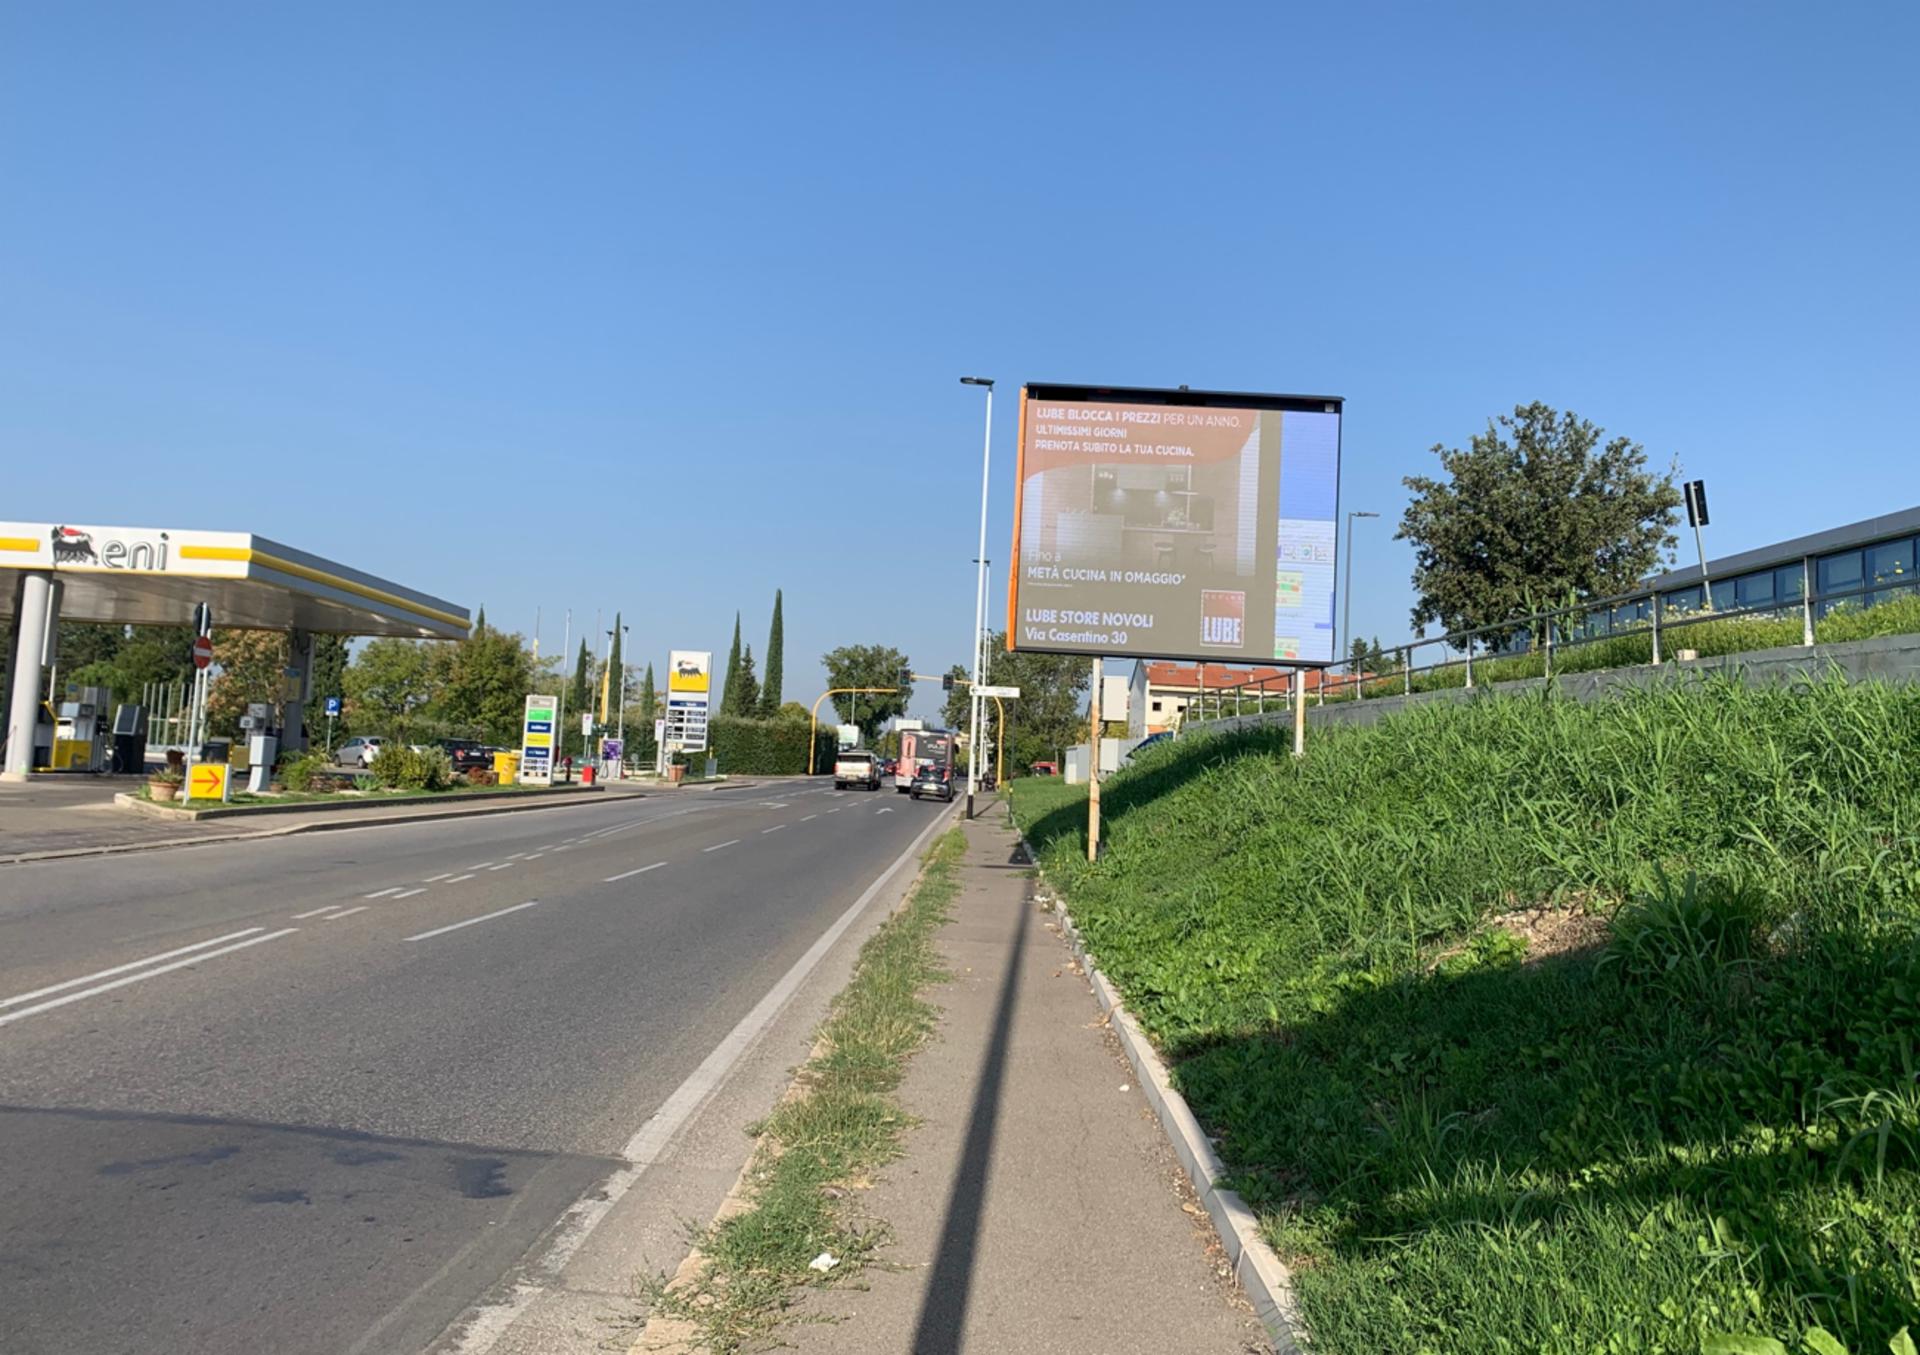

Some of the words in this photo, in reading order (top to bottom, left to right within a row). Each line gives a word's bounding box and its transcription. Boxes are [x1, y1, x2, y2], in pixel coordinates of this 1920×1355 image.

[1036, 407, 1065, 420] LUBE
[1067, 409, 1113, 421] BLOCCA
[1115, 411, 1120, 422] I
[1122, 411, 1161, 424] PREZZI
[1163, 413, 1185, 425] PER
[1187, 414, 1204, 426] UN
[1206, 415, 1241, 428] ANNO.
[1035, 424, 1092, 437] ULTIMISSIMI
[1093, 426, 1128, 438] GIORNI
[1034, 439, 1080, 451] PRENOTA
[1082, 441, 1117, 453] SUBITO
[1119, 443, 1132, 454] LA
[1134, 444, 1153, 455] TUA
[1155, 445, 1195, 457] CUCINA.
[101, 531, 169, 571] eni
[1027, 564, 1060, 580] METÀ
[1062, 568, 1107, 582] CUCINA
[1109, 570, 1122, 583] IN
[1025, 608, 1058, 624] LUBE
[1059, 610, 1100, 626] STORE
[1102, 612, 1154, 628] NOVOLI
[1025, 626, 1046, 641] Via
[1049, 628, 1109, 644] Casentino
[1111, 631, 1128, 645] 30
[1203, 615, 1241, 644] LUBE
